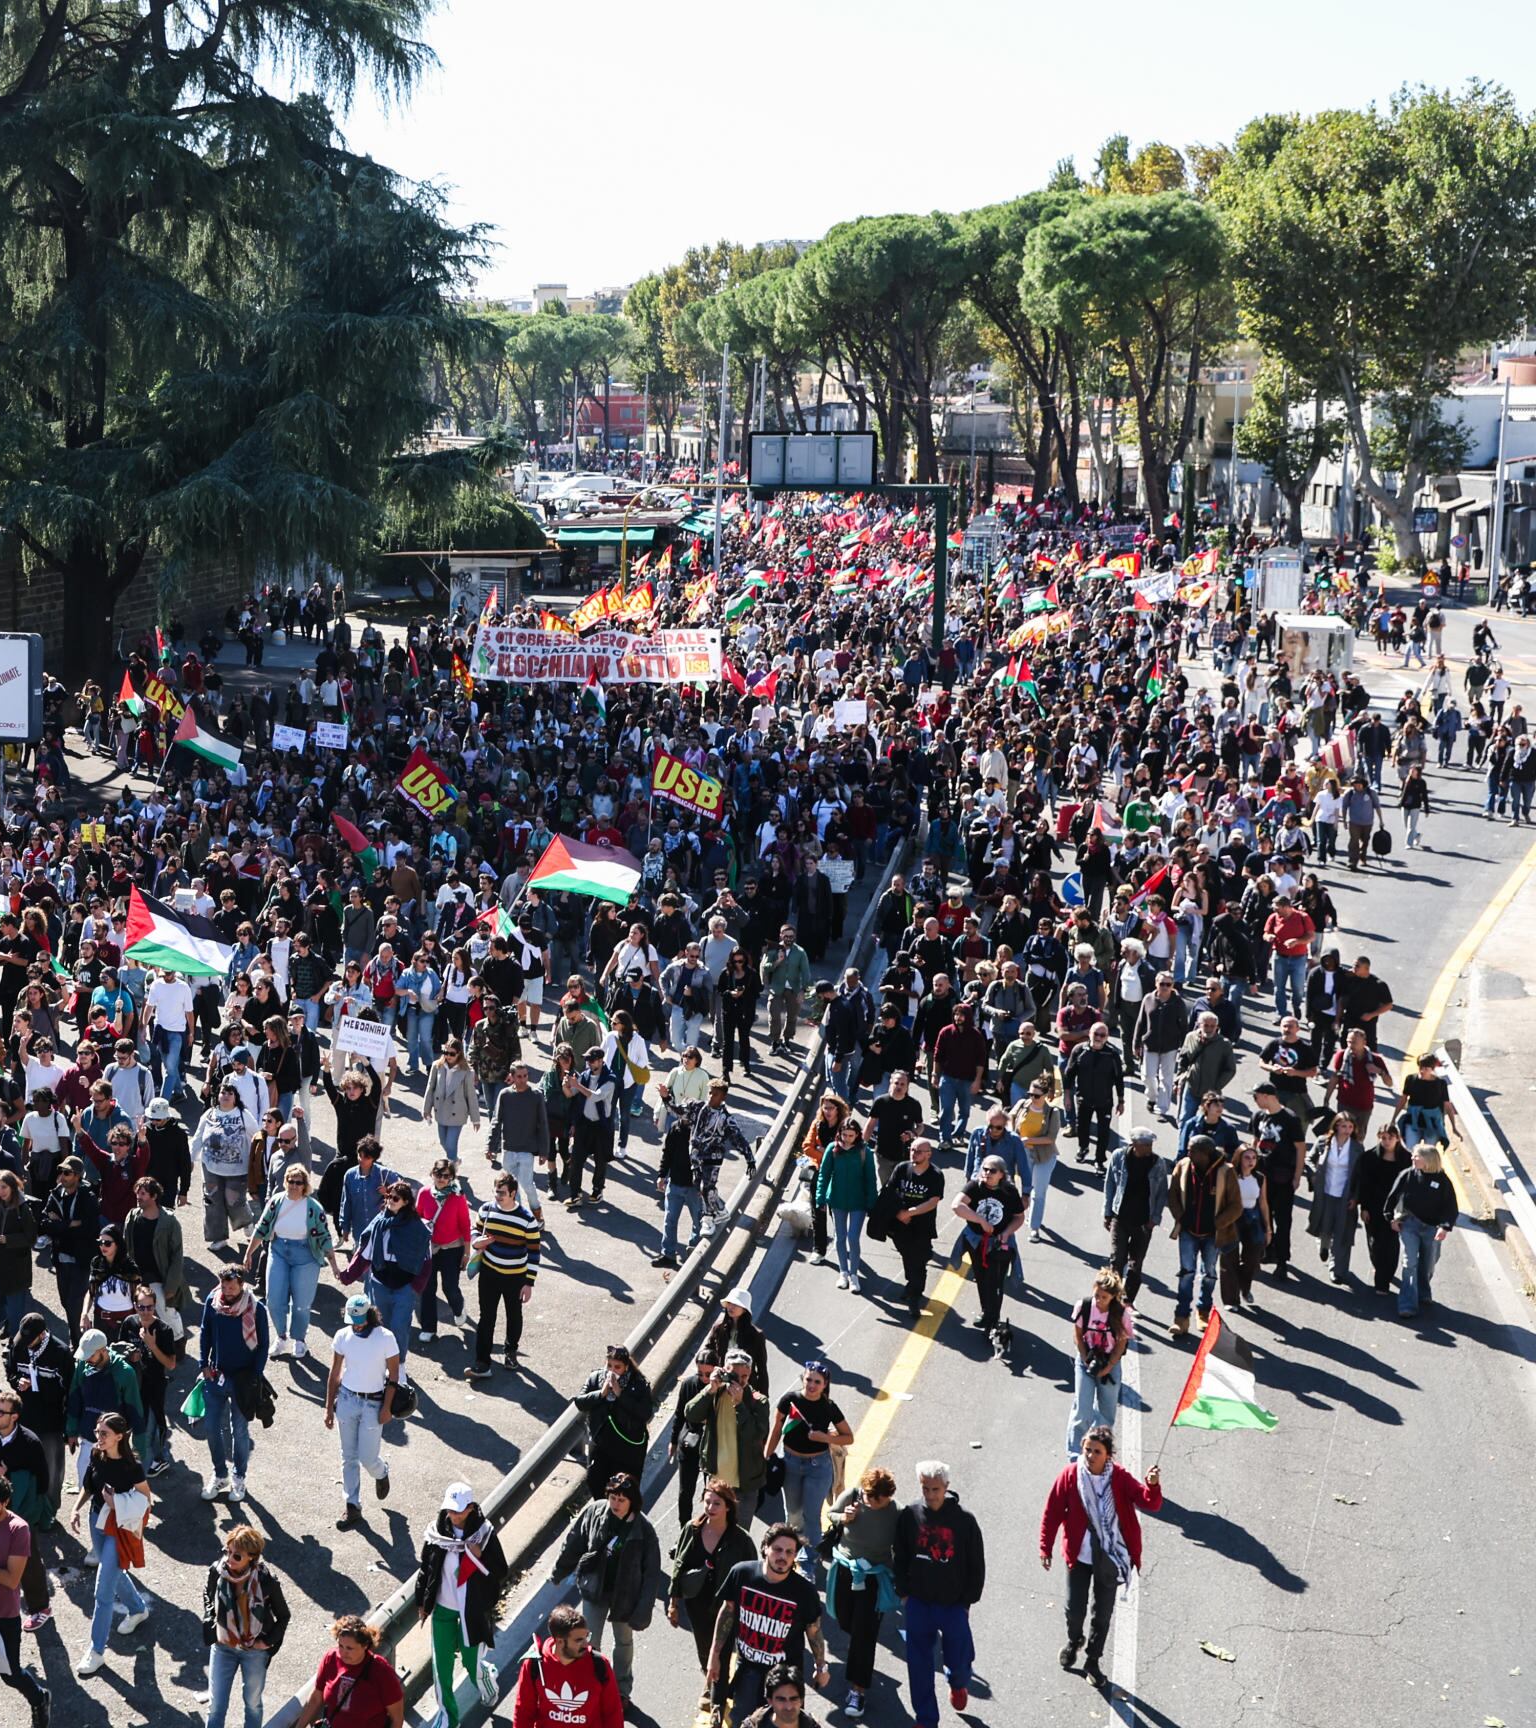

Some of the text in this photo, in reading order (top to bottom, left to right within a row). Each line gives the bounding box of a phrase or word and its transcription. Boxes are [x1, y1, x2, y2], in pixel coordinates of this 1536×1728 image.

[481, 630, 491, 643] 3
[495, 631, 552, 646] OTTOBRE
[631, 633, 706, 650] GNERALE
[685, 660, 710, 673] USB
[653, 756, 722, 810] USB
[740, 1588, 798, 1624] LOVE
[739, 1606, 792, 1639] RUNNING
[549, 1710, 586, 1724] adidas
